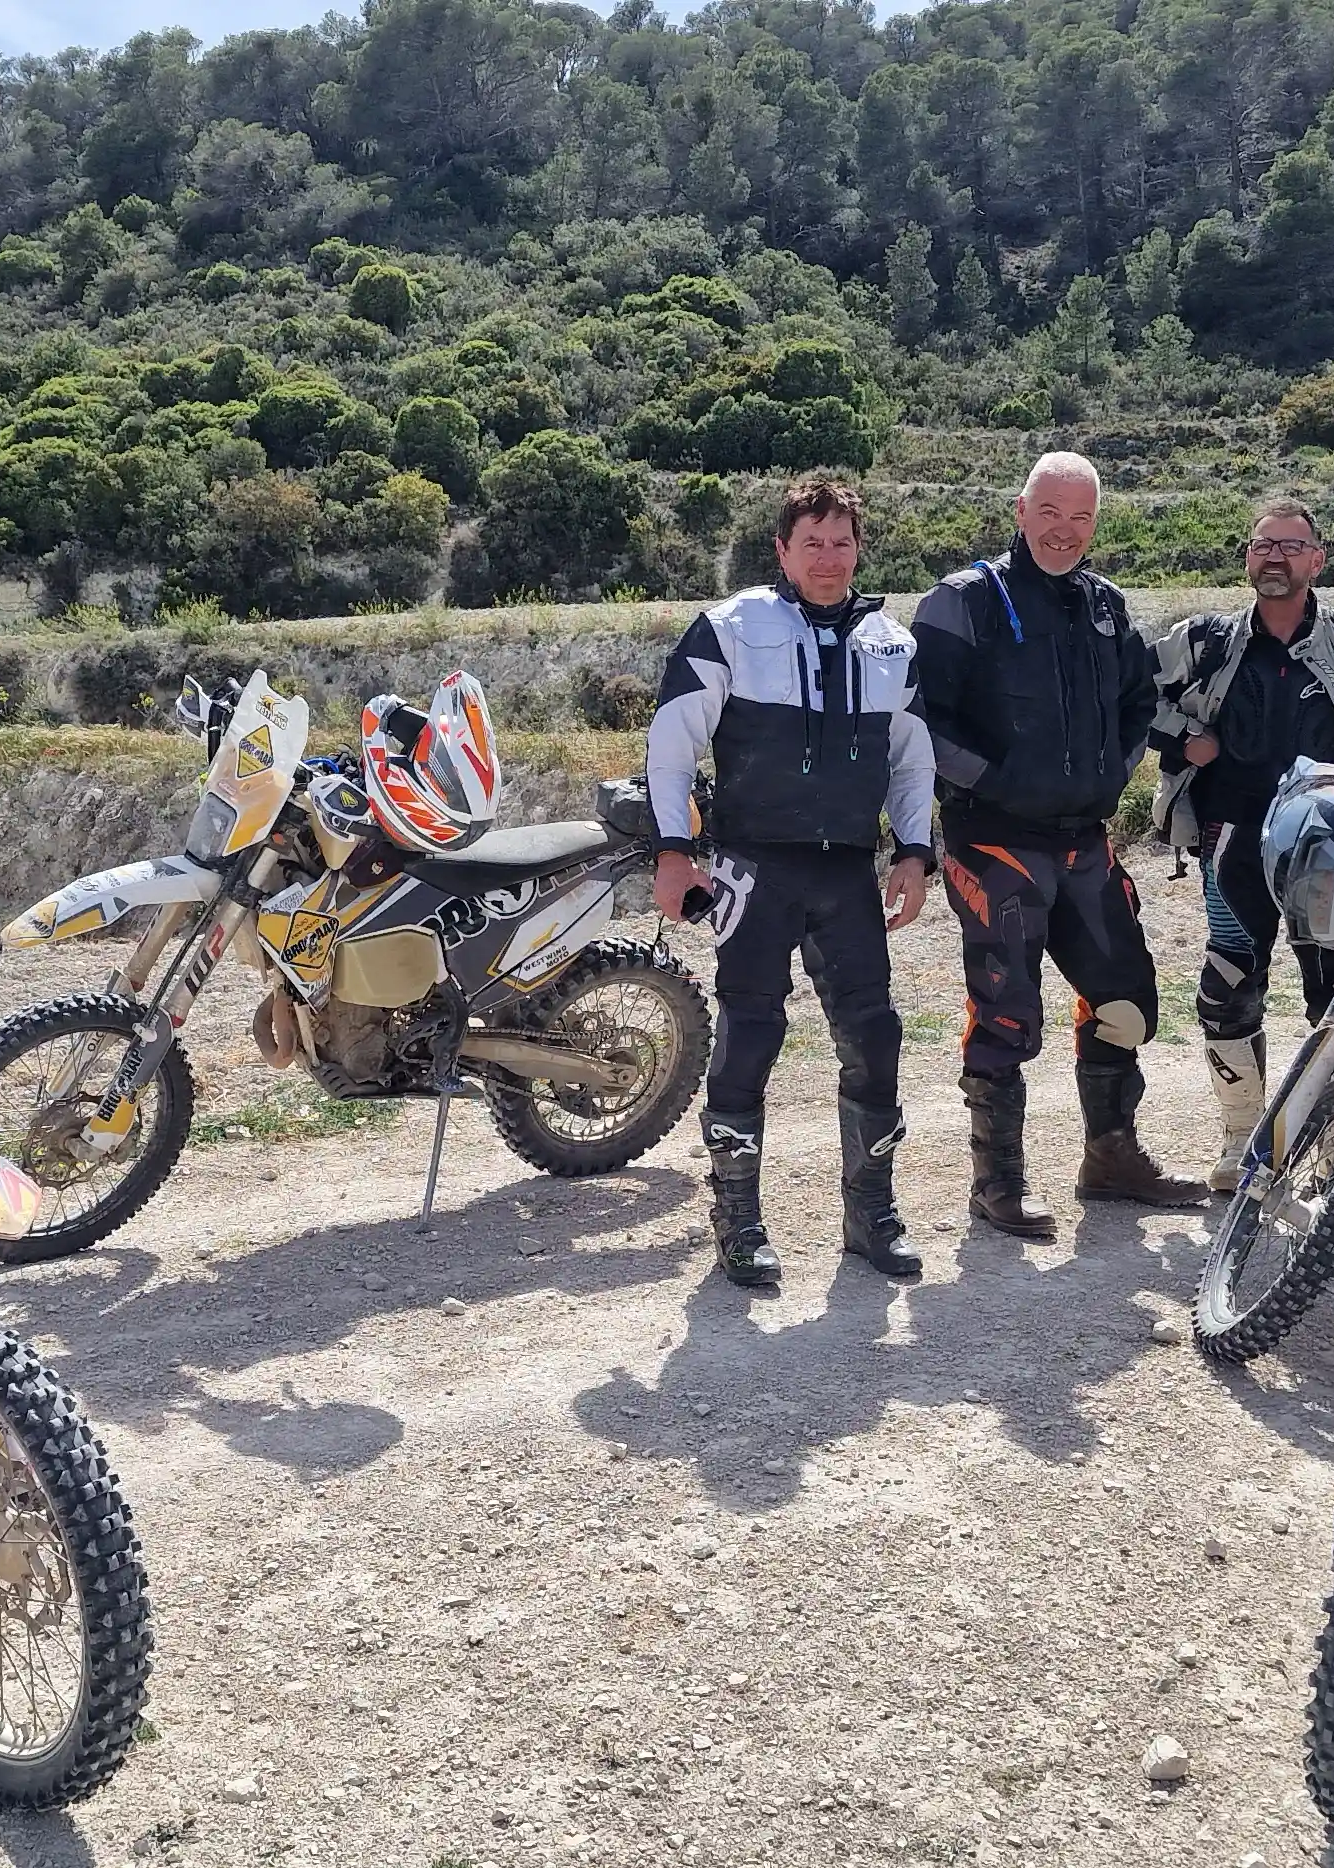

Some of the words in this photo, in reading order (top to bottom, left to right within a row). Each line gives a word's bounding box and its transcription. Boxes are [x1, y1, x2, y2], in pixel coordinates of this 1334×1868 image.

[868, 643, 906, 657] THOR
[524, 945, 568, 973] WESTWIND
[546, 951, 570, 969] MOTO
